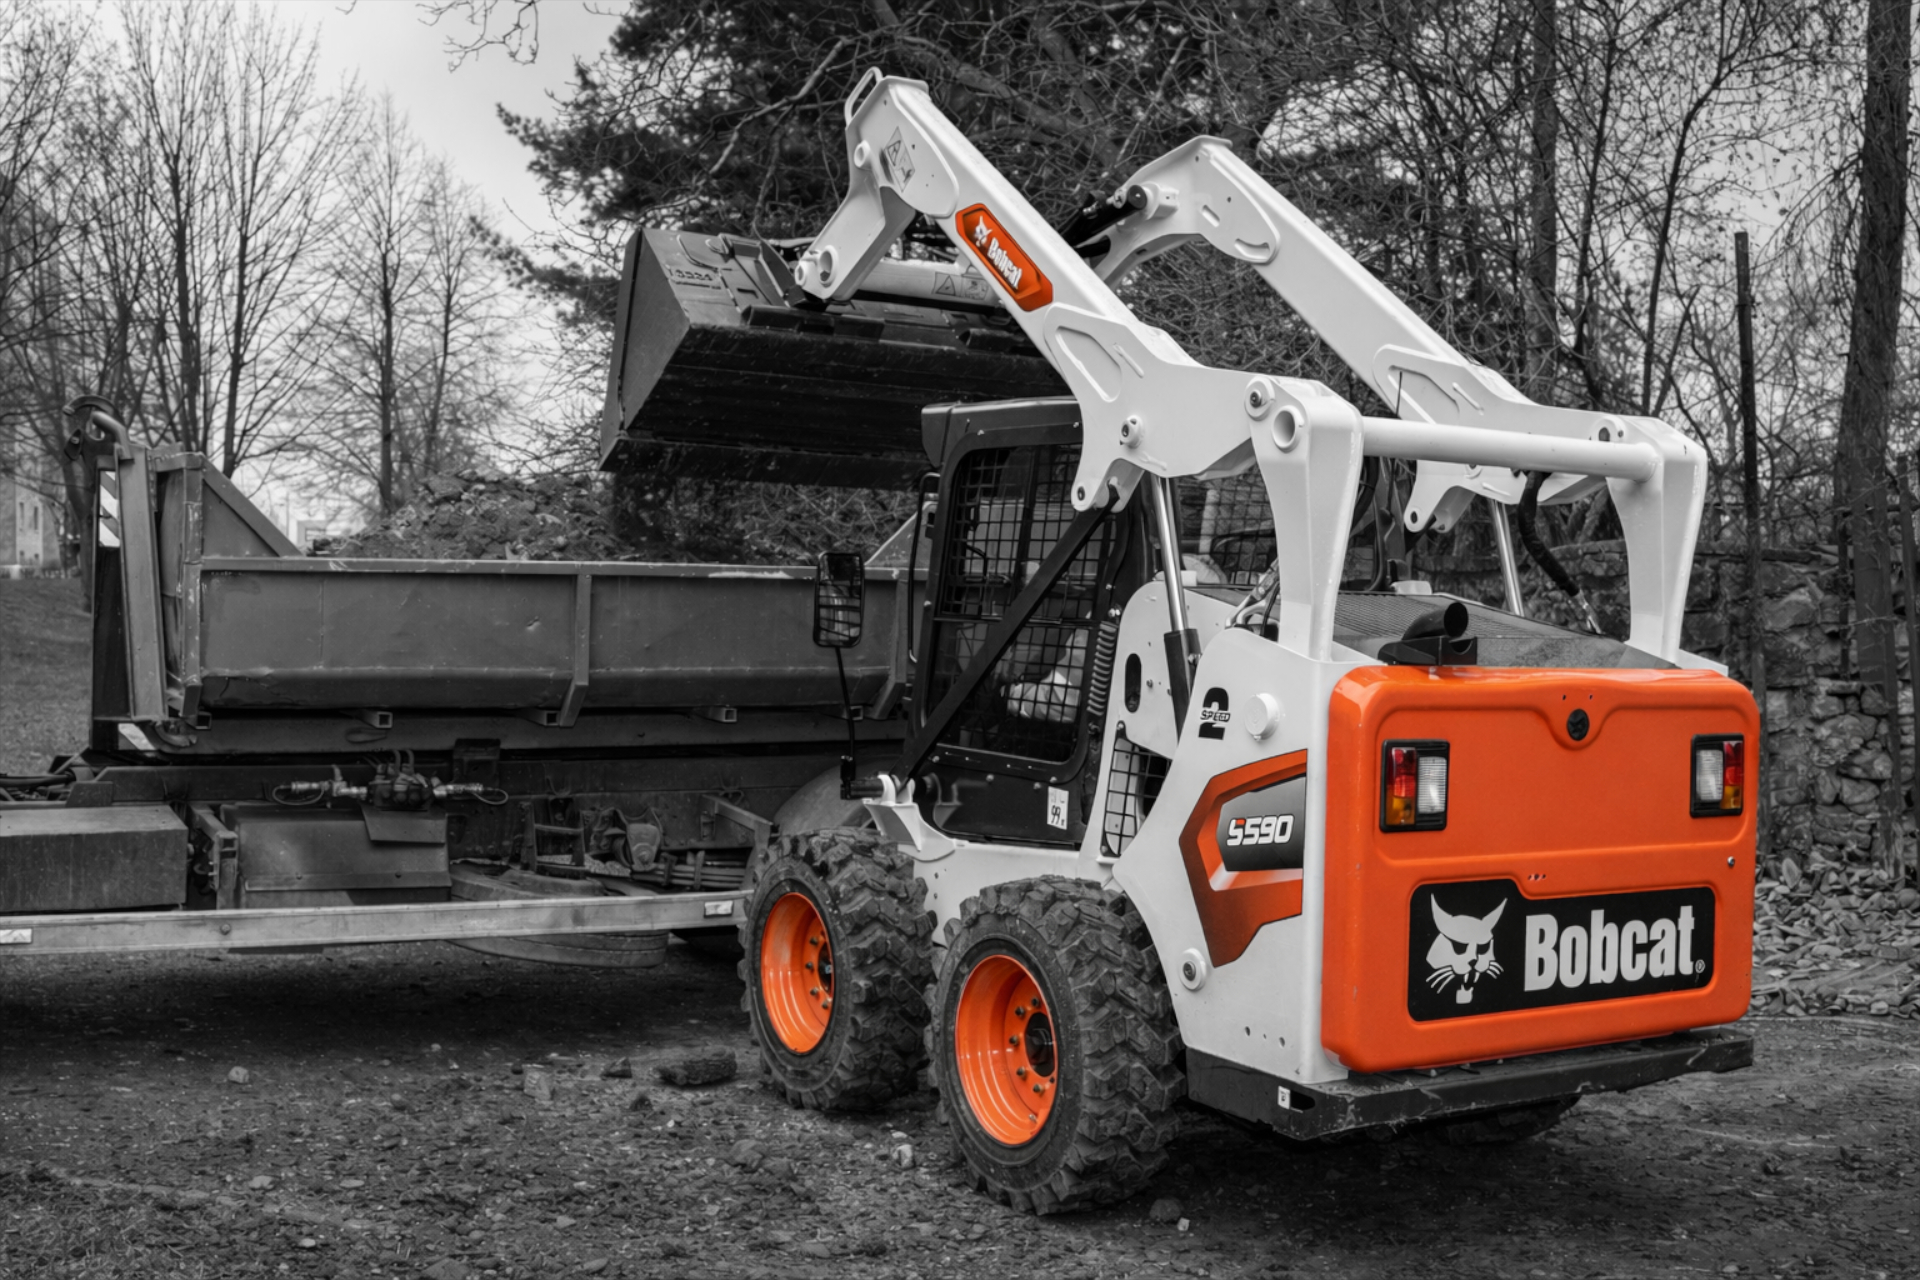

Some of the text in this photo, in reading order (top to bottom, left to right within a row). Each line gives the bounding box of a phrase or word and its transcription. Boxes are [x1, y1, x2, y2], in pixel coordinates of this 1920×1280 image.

[987, 237, 1022, 290] Bobcat
[1198, 686, 1229, 740] 2
[1200, 709, 1231, 723] SPEED
[1226, 815, 1294, 846] S590
[1524, 905, 1695, 992] Bobcat
